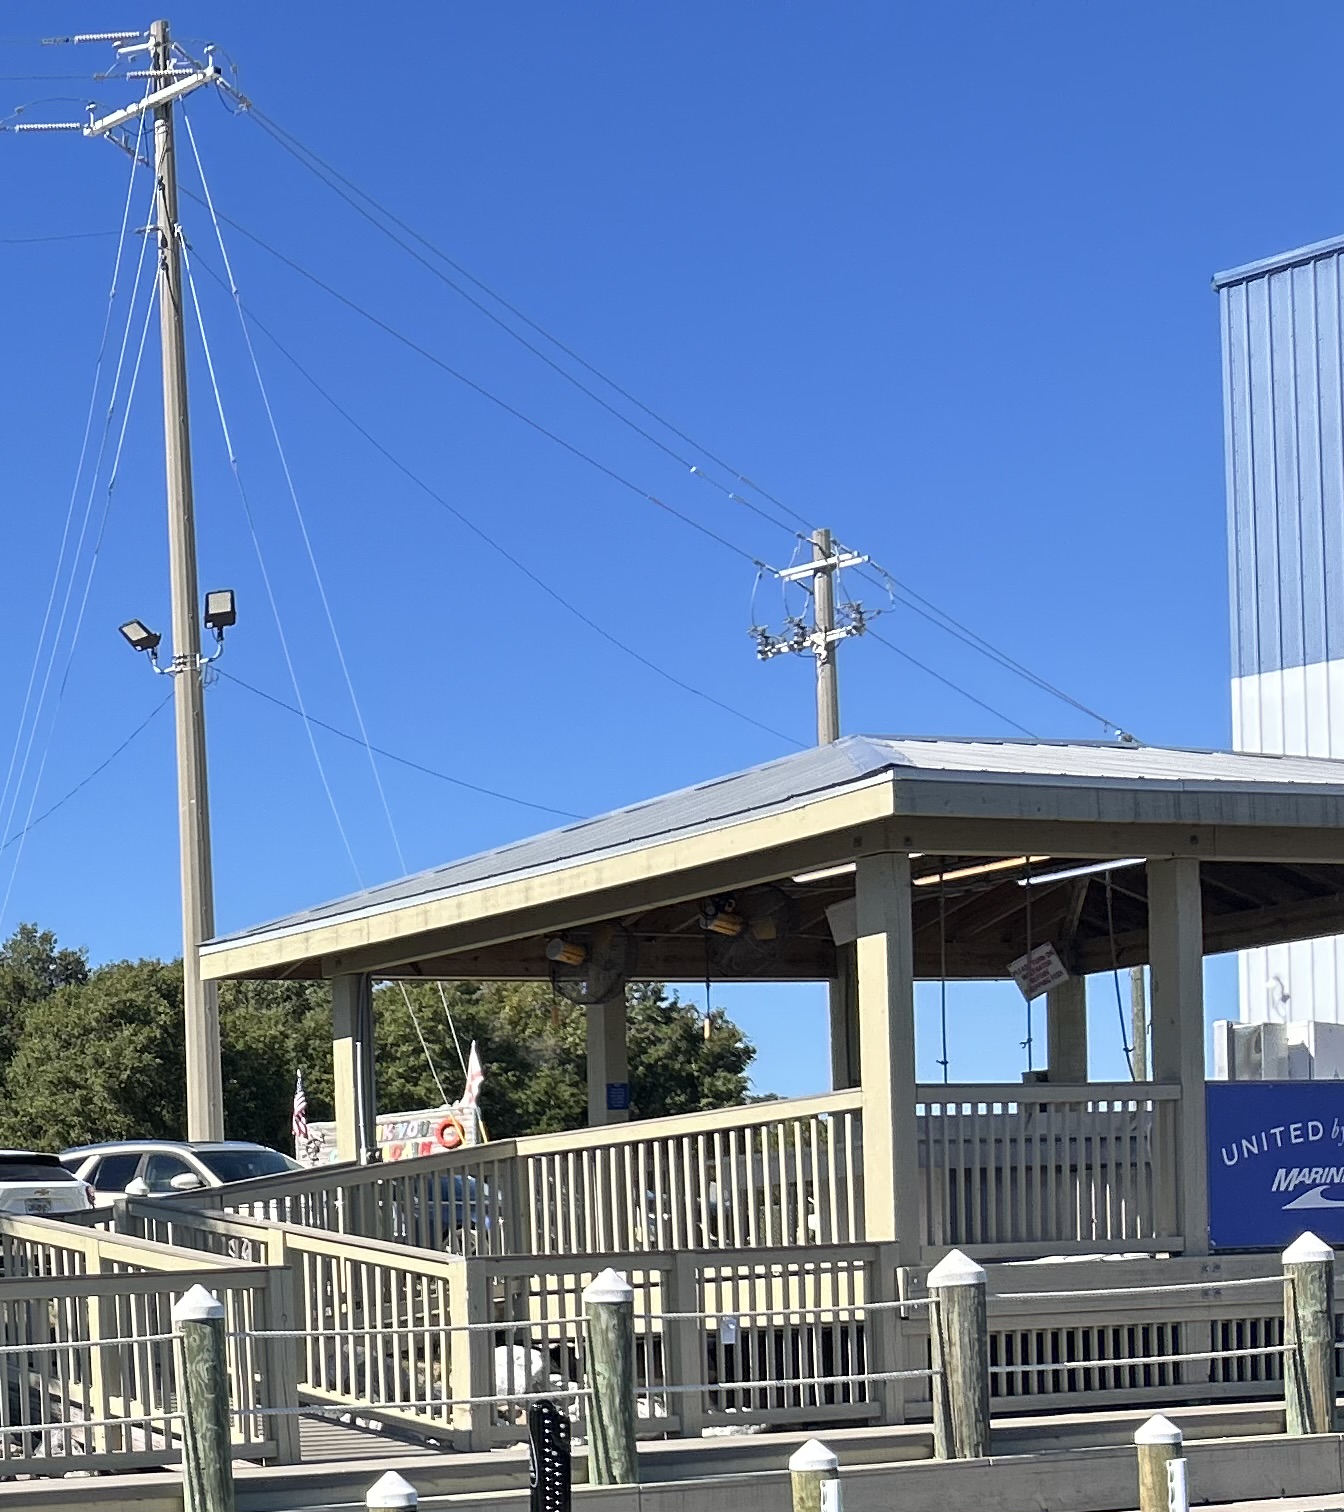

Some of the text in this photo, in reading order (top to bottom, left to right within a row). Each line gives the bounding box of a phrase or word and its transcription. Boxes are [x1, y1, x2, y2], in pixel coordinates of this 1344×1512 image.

[396, 1120, 431, 1139] YOU
[1221, 1120, 1324, 1166] UNITED
[1271, 1166, 1344, 1192] MARIN
